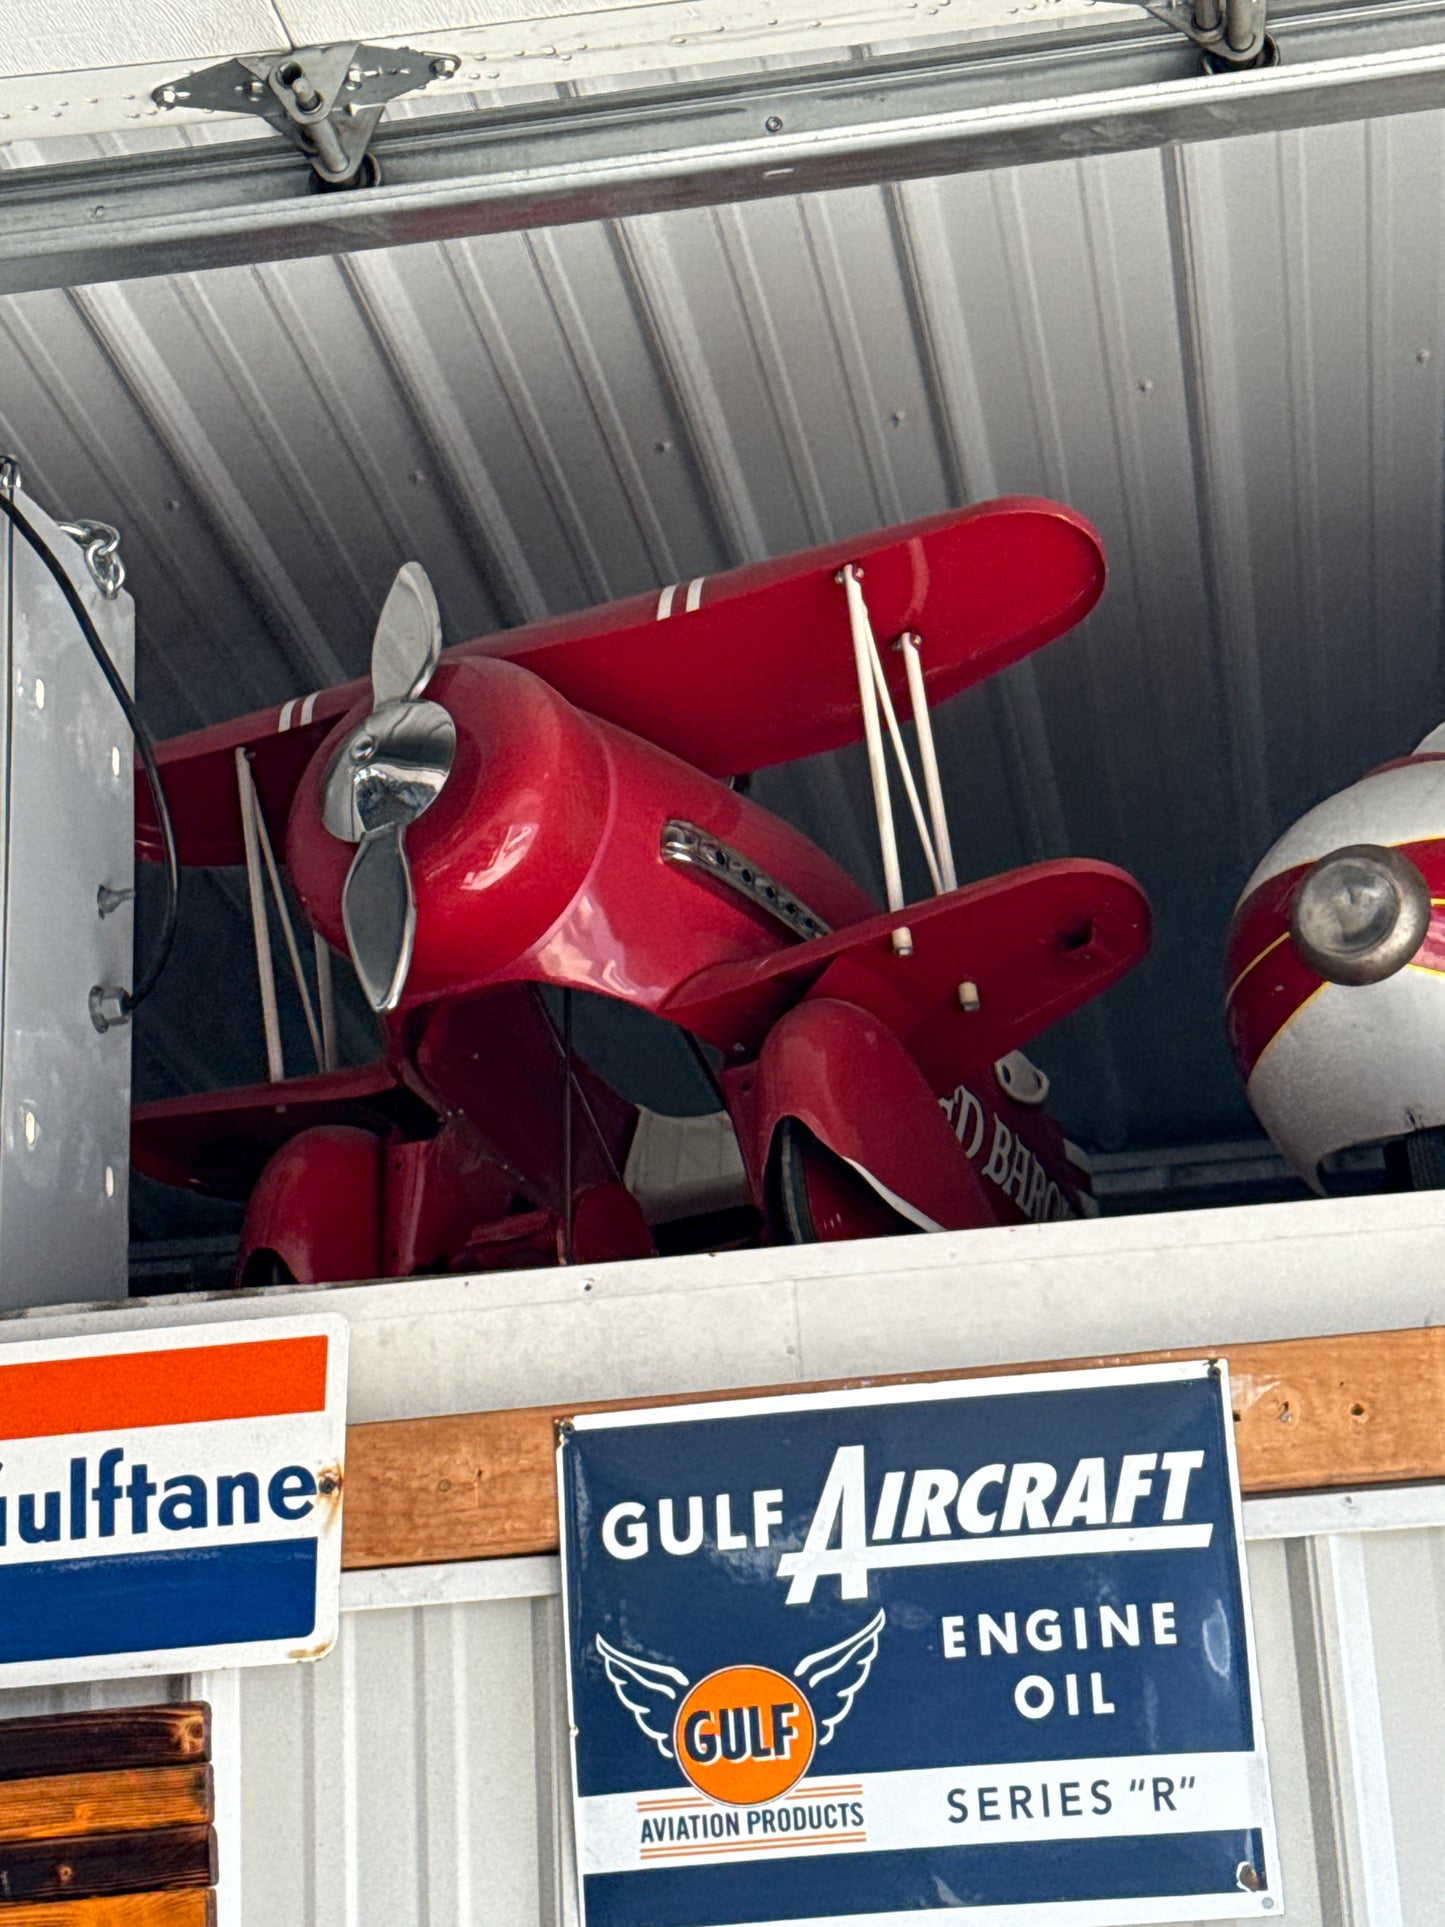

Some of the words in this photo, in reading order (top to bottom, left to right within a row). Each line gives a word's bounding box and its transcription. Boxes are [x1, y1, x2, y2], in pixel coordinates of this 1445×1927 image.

[0, 1446, 317, 1546] ulftane
[601, 1488, 784, 1560] GULF
[776, 1445, 1213, 1604] AIRCRAFT
[941, 1602, 1178, 1659] ENGINE
[1014, 1671, 1116, 1720] OIL
[683, 1702, 799, 1767] GULF
[640, 1811, 741, 1844] AVIATION
[746, 1802, 865, 1835] PRODUCTS
[947, 1779, 1113, 1824] SERIES
